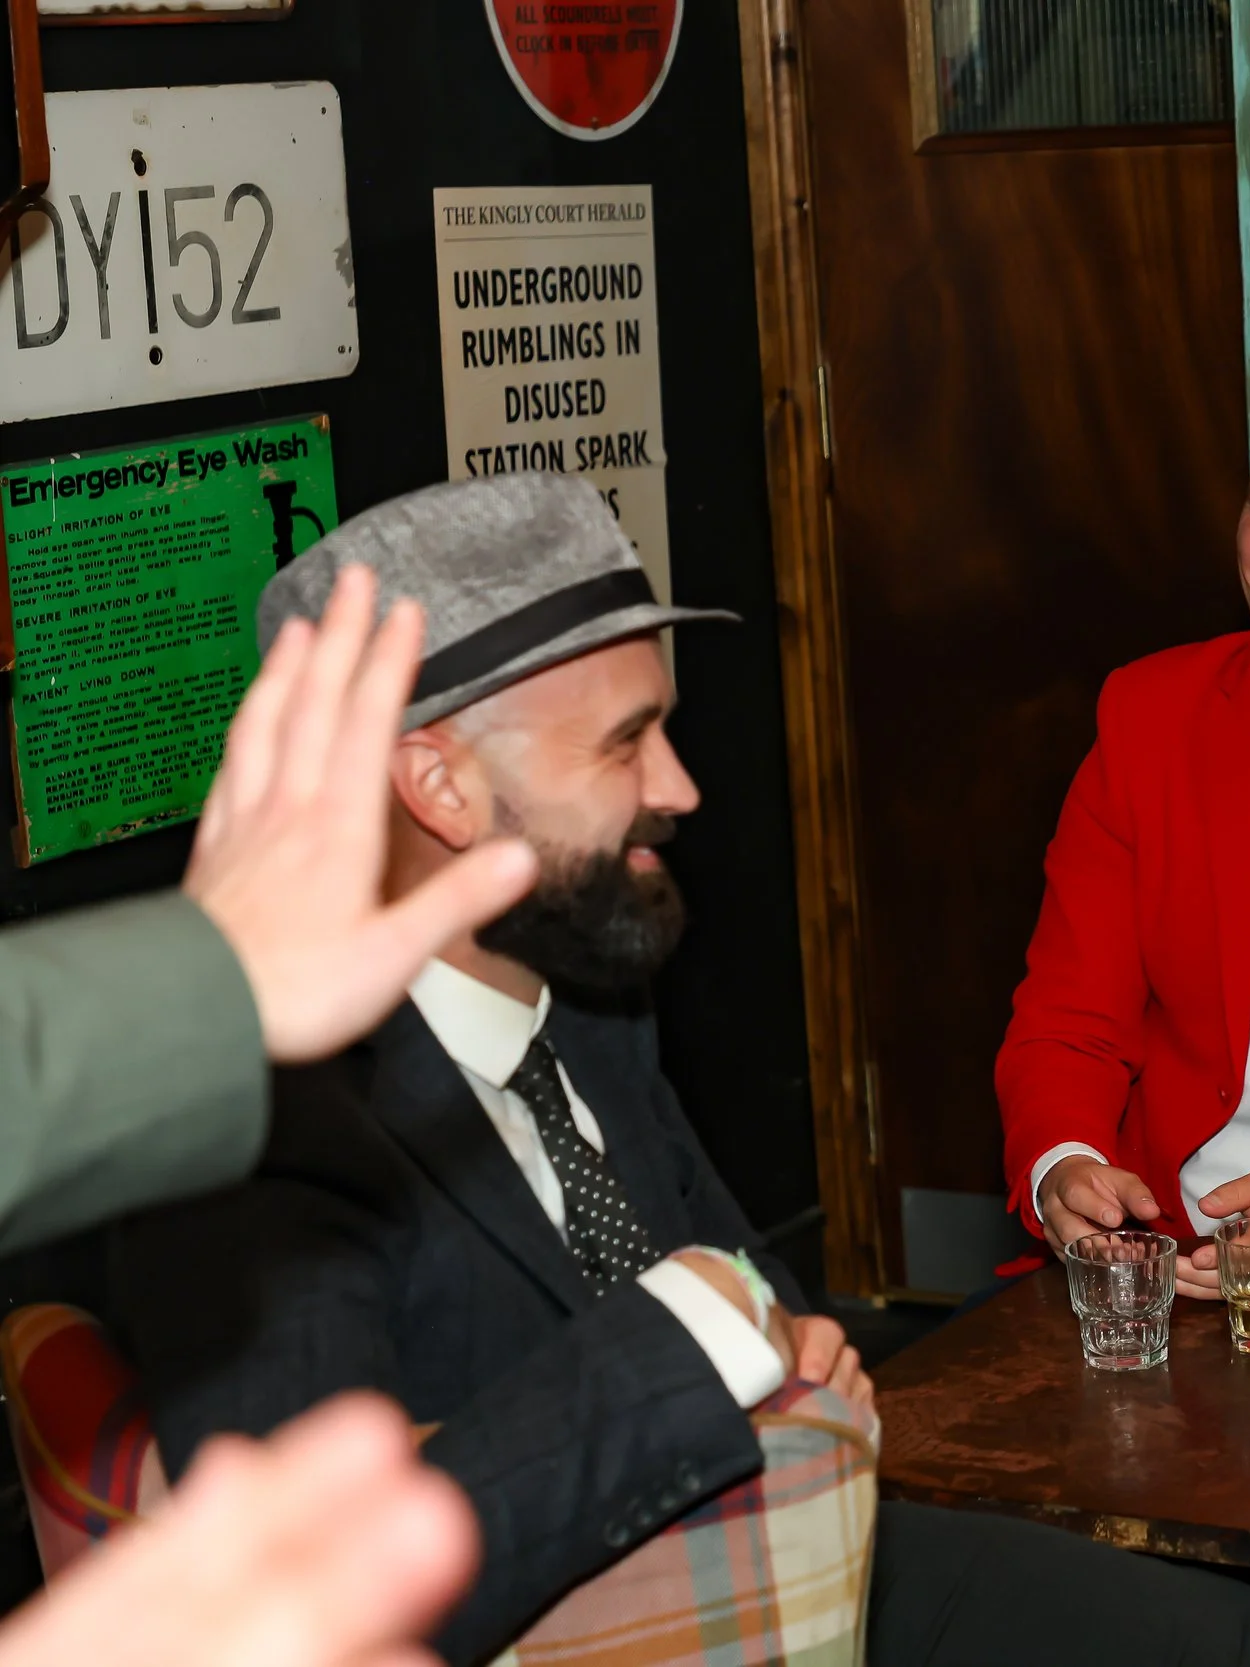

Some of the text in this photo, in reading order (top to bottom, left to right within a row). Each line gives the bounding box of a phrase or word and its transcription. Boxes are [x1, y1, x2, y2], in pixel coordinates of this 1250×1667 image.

[515, 5, 537, 24] ALL
[516, 35, 554, 53] CLOCK
[559, 35, 571, 52] IN
[443, 203, 645, 225] THE KINGLY COURT HERALD
[454, 264, 642, 309] UNDERGROUND
[462, 320, 639, 368] RUMBLINGS IN
[505, 379, 605, 423] DISUSED
[9, 433, 308, 507] Emergency Eye Wash
[465, 431, 651, 479] STATION SPARK
[8, 504, 170, 543] SLIGHT IRRITATION OF EYE
[28, 524, 169, 556] Hold eye open with thumb and
[11, 560, 47, 571] remove
[77, 549, 102, 559] cover
[106, 544, 122, 553] and
[159, 536, 173, 544] eye
[177, 532, 196, 541] bath
[79, 561, 105, 570] bottle
[108, 555, 136, 567] gently
[140, 550, 157, 559] and
[163, 541, 211, 555] repeatedly
[13, 584, 51, 596] cleanse
[85, 570, 112, 581] Divert
[118, 565, 139, 576] used
[147, 560, 171, 570] wash
[178, 555, 202, 564] away
[14, 598, 37, 607] body
[43, 588, 80, 601] through
[86, 583, 111, 593] drain
[16, 587, 176, 628] SEVERE IRRITATION OF EYE
[36, 633, 53, 641] Eye
[59, 625, 89, 636] closes
[176, 602, 195, 612] thus
[18, 647, 42, 657] ance
[110, 626, 139, 636] Helper
[144, 618, 173, 629] should
[198, 610, 212, 618] eye
[19, 659, 37, 669] and
[42, 653, 67, 664] wash
[85, 645, 104, 654] with
[109, 640, 125, 649] eye
[130, 634, 150, 644] bath
[34, 667, 62, 679] gently
[69, 660, 86, 670] and
[92, 649, 140, 664] repeatedly
[145, 638, 191, 653] squeezing
[196, 633, 210, 641] the
[214, 627, 240, 637] bottle
[23, 666, 155, 704] PATIENT LYING DOWN
[41, 674, 199, 716] Helper should unscrew bath and
[27, 733, 48, 744] bath
[54, 727, 71, 737] and
[76, 722, 98, 732] valve
[157, 703, 176, 712] Hold
[28, 747, 44, 756] eye
[51, 740, 71, 750] bath
[109, 724, 138, 736] inches
[144, 719, 165, 728] away
[215, 703, 228, 711] the
[67, 709, 101, 722] remove
[106, 705, 120, 713] the
[123, 701, 136, 709] dip
[43, 754, 69, 766] gently
[73, 748, 89, 759] and
[93, 737, 139, 753] repeatedly
[200, 719, 214, 727] the
[46, 768, 84, 783] ALWAYS
[151, 745, 176, 756] WASH
[182, 738, 198, 747] THE
[46, 746, 213, 794] REPLACE BATH COVER AFTER USE
[47, 752, 222, 804] ENSURE THAT THE EYEWASH BOTTLE
[48, 793, 108, 814] MAINTAINED
[119, 785, 142, 796] FULL
[152, 777, 171, 788] AND
[122, 787, 173, 806] CONDITION
